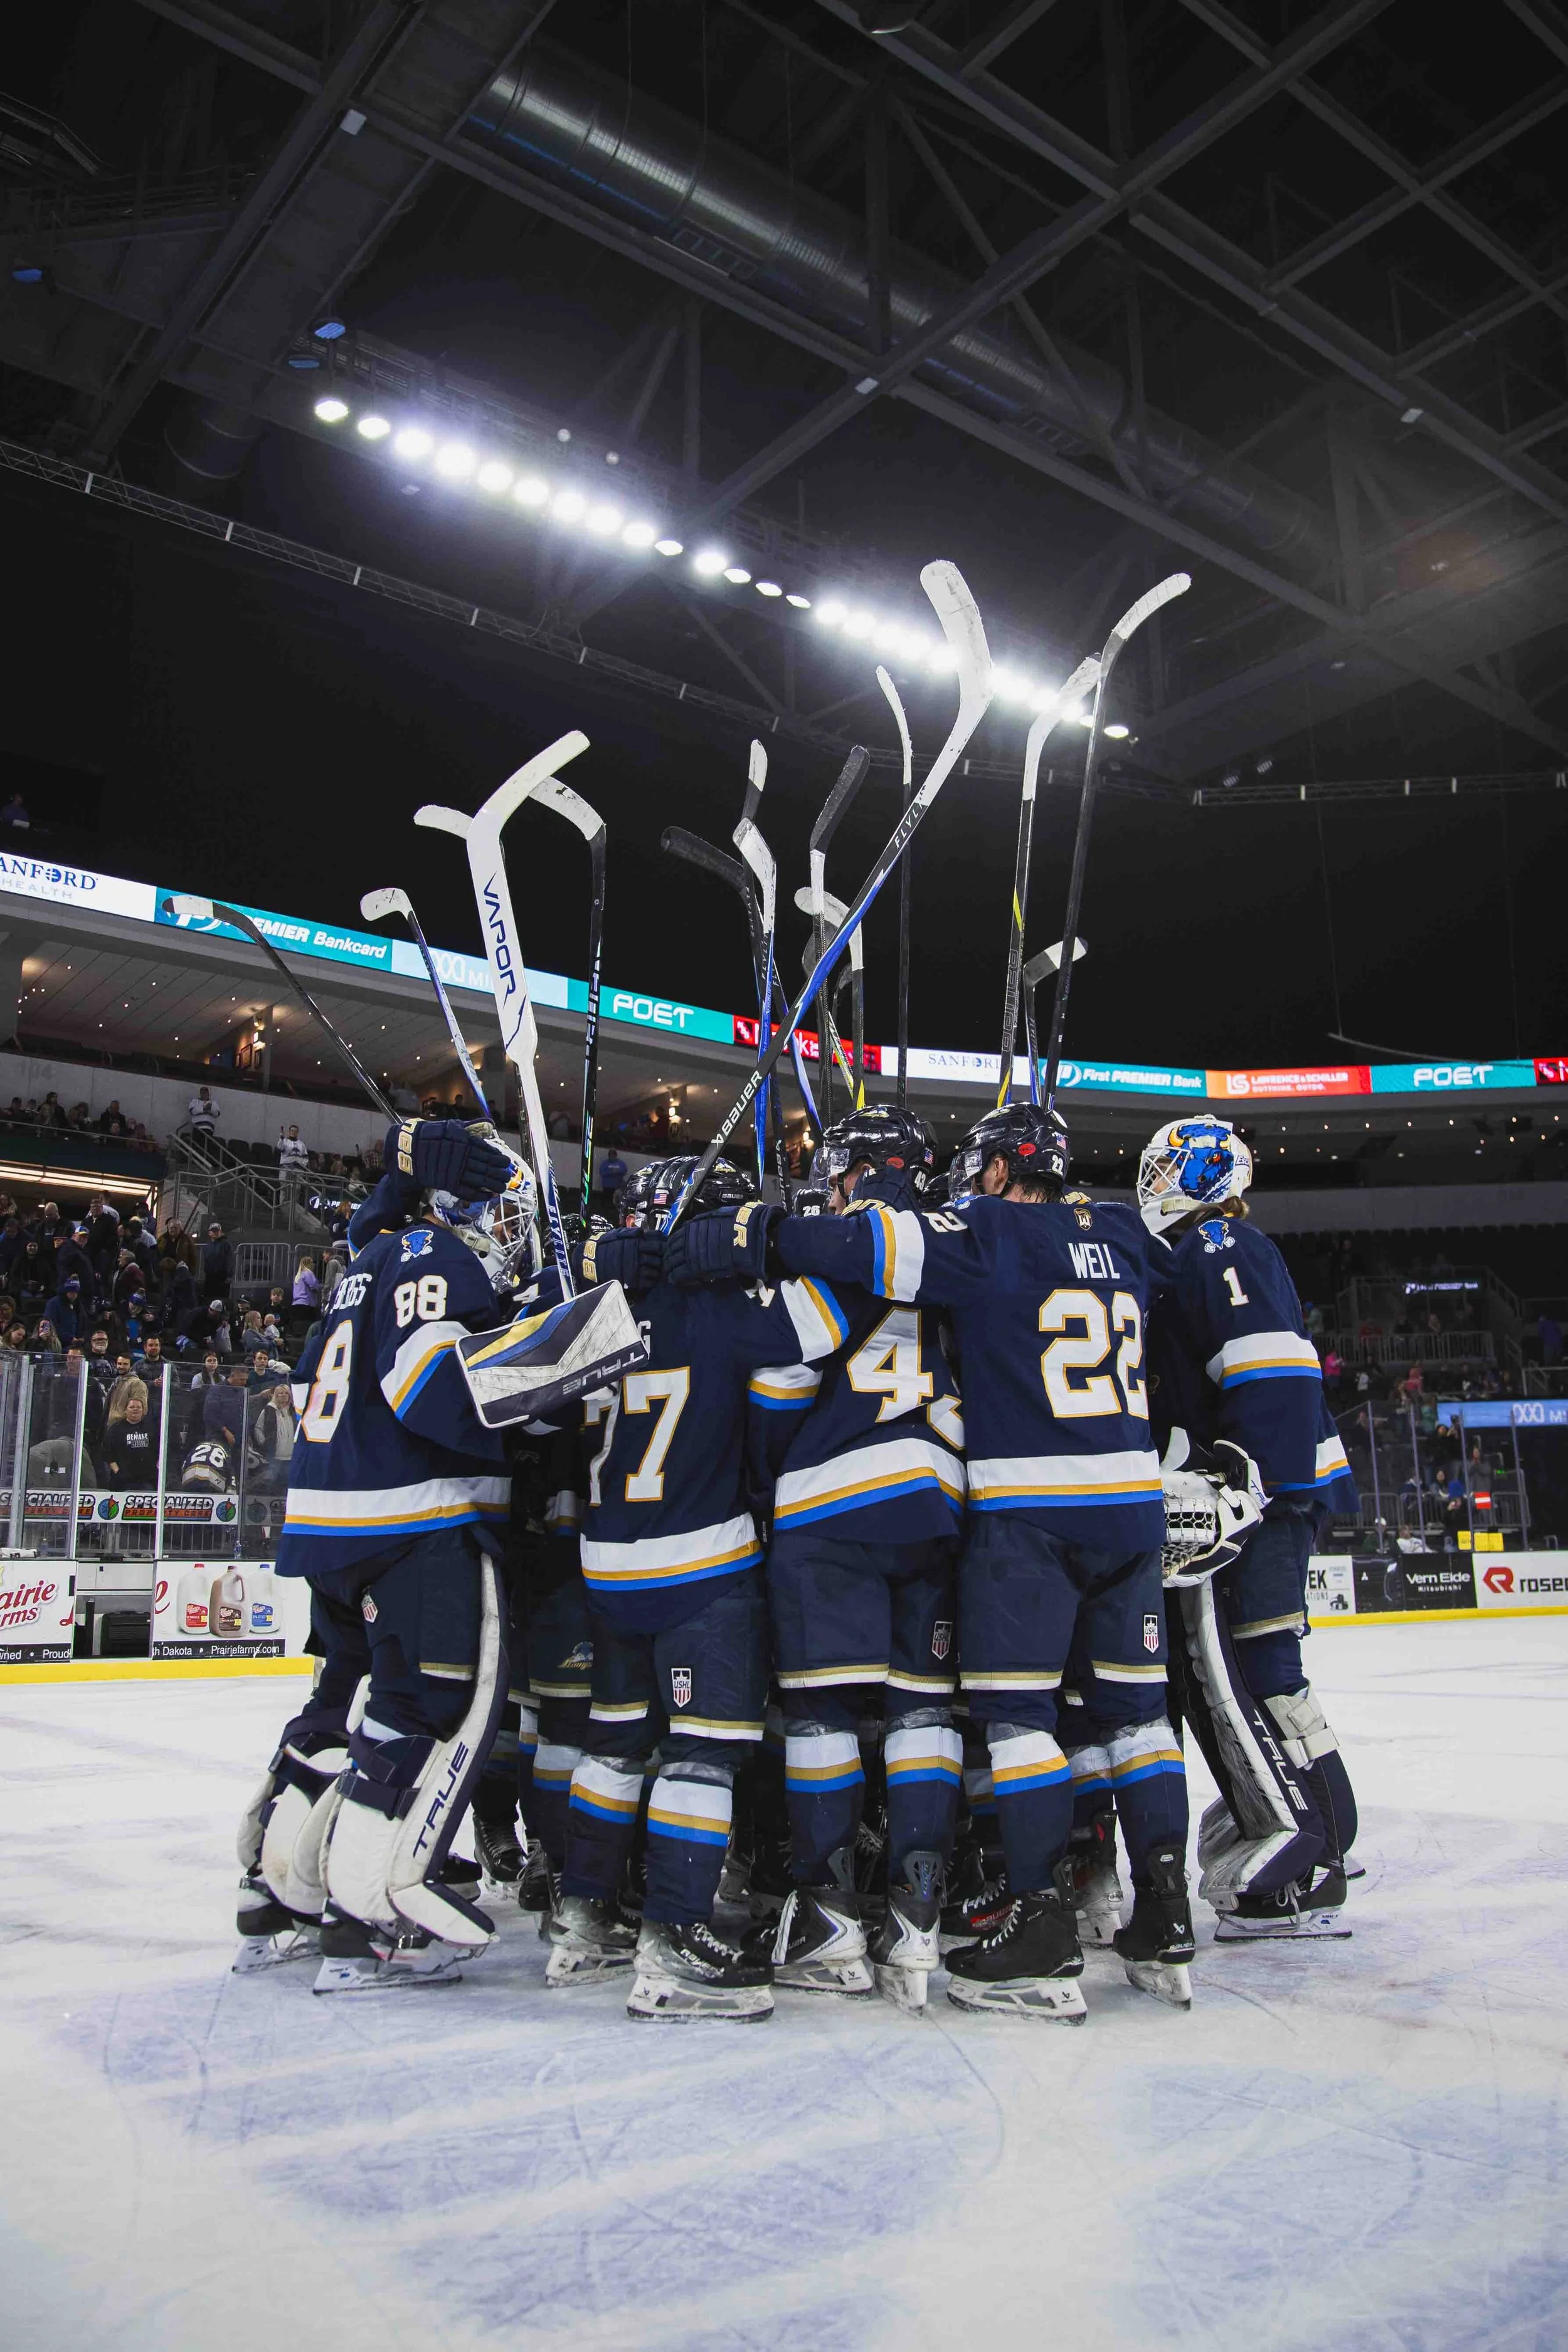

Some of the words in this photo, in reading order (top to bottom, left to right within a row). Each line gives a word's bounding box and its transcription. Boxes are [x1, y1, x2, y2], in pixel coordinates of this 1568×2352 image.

[250, 917, 310, 943] EMIER
[313, 931, 386, 959] Bankcard
[484, 871, 516, 1009] VAPOR
[613, 993, 694, 1029] POET
[1083, 1069, 1110, 1082] First
[1111, 1070, 1172, 1086] PREMIER
[1173, 1074, 1202, 1088] Bank
[1413, 1065, 1494, 1088] POET
[721, 1070, 763, 1136] BAUER
[1052, 1148, 1063, 1175] 22
[914, 1170, 926, 1190] 43
[803, 1205, 820, 1217] 26
[546, 1204, 569, 1278] FLYLITE
[1068, 1242, 1120, 1279] WEIL
[1223, 1266, 1249, 1306] 1
[394, 1274, 448, 1328] 88
[1038, 1289, 1150, 1420] 22
[563, 1352, 645, 1396] TRUE
[190, 1444, 226, 1468] 26
[125, 1496, 213, 1509] SPECALIZED
[1309, 1570, 1328, 1589] EK
[1406, 1573, 1438, 1585] Vern
[1440, 1572, 1471, 1583] Eide
[0, 1608, 38, 1627] rms
[934, 1632, 950, 1642] USHL
[1146, 1627, 1158, 1635] USHL
[162, 1646, 193, 1656] Dakota
[211, 1645, 280, 1656] Prairiefarms.com
[674, 1680, 691, 1690] USHL
[1254, 1708, 1309, 1811] TRUE
[413, 1741, 469, 1858] TRUE
